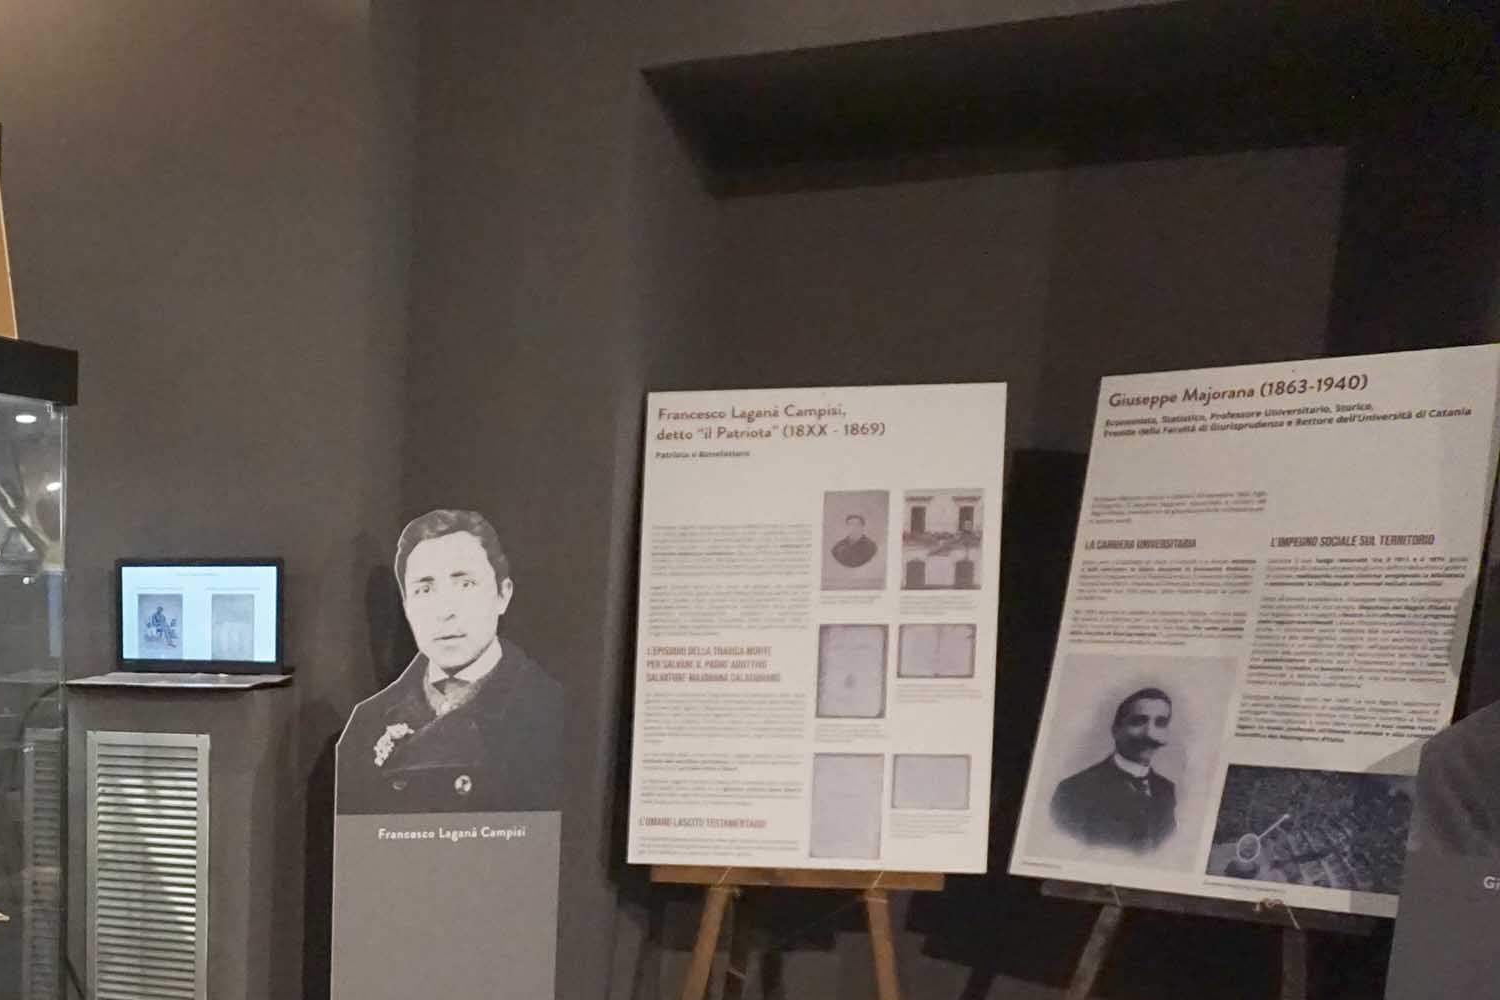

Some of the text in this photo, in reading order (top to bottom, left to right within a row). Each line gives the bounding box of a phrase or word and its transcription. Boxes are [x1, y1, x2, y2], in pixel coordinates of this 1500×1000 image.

[1108, 373, 1368, 410] Giuseppe Majorana (1863-1940)
[657, 403, 846, 423] Francesco Laganà Campisi,
[1428, 407, 1472, 418] Catania
[654, 427, 693, 441] detto
[696, 426, 712, 440] "il
[716, 425, 777, 439] Patriota"
[782, 422, 828, 438] (18XX
[843, 421, 885, 436] 1869)
[1270, 533, 1435, 547] L'IMPEGNO SOCIALE SUL TERRITORIO
[377, 826, 525, 842] Francesco Laganà Campisi
